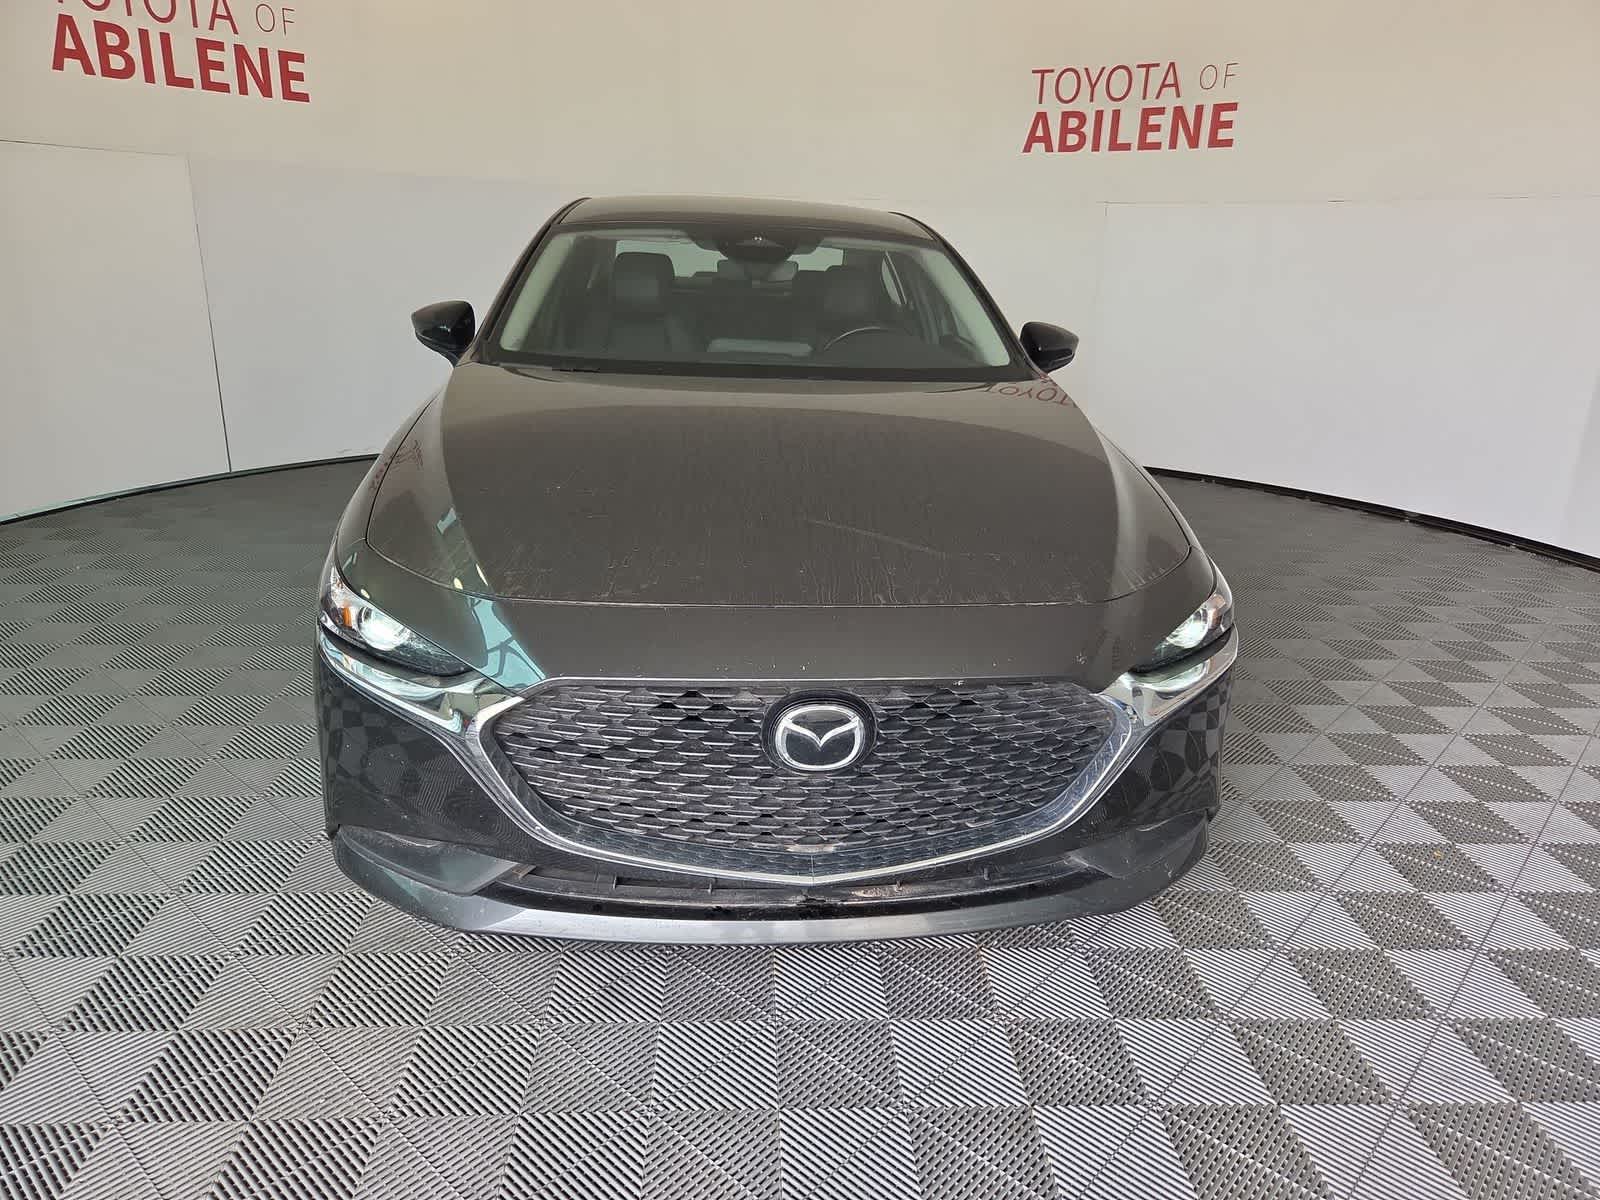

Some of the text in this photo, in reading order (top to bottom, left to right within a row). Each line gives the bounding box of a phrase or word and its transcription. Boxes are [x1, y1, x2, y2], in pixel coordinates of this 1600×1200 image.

[255, 3, 295, 36] OF
[51, 12, 311, 104] ABILENE
[1031, 61, 1239, 105] TOYOTA OF
[1022, 102, 1240, 154] ABILENE
